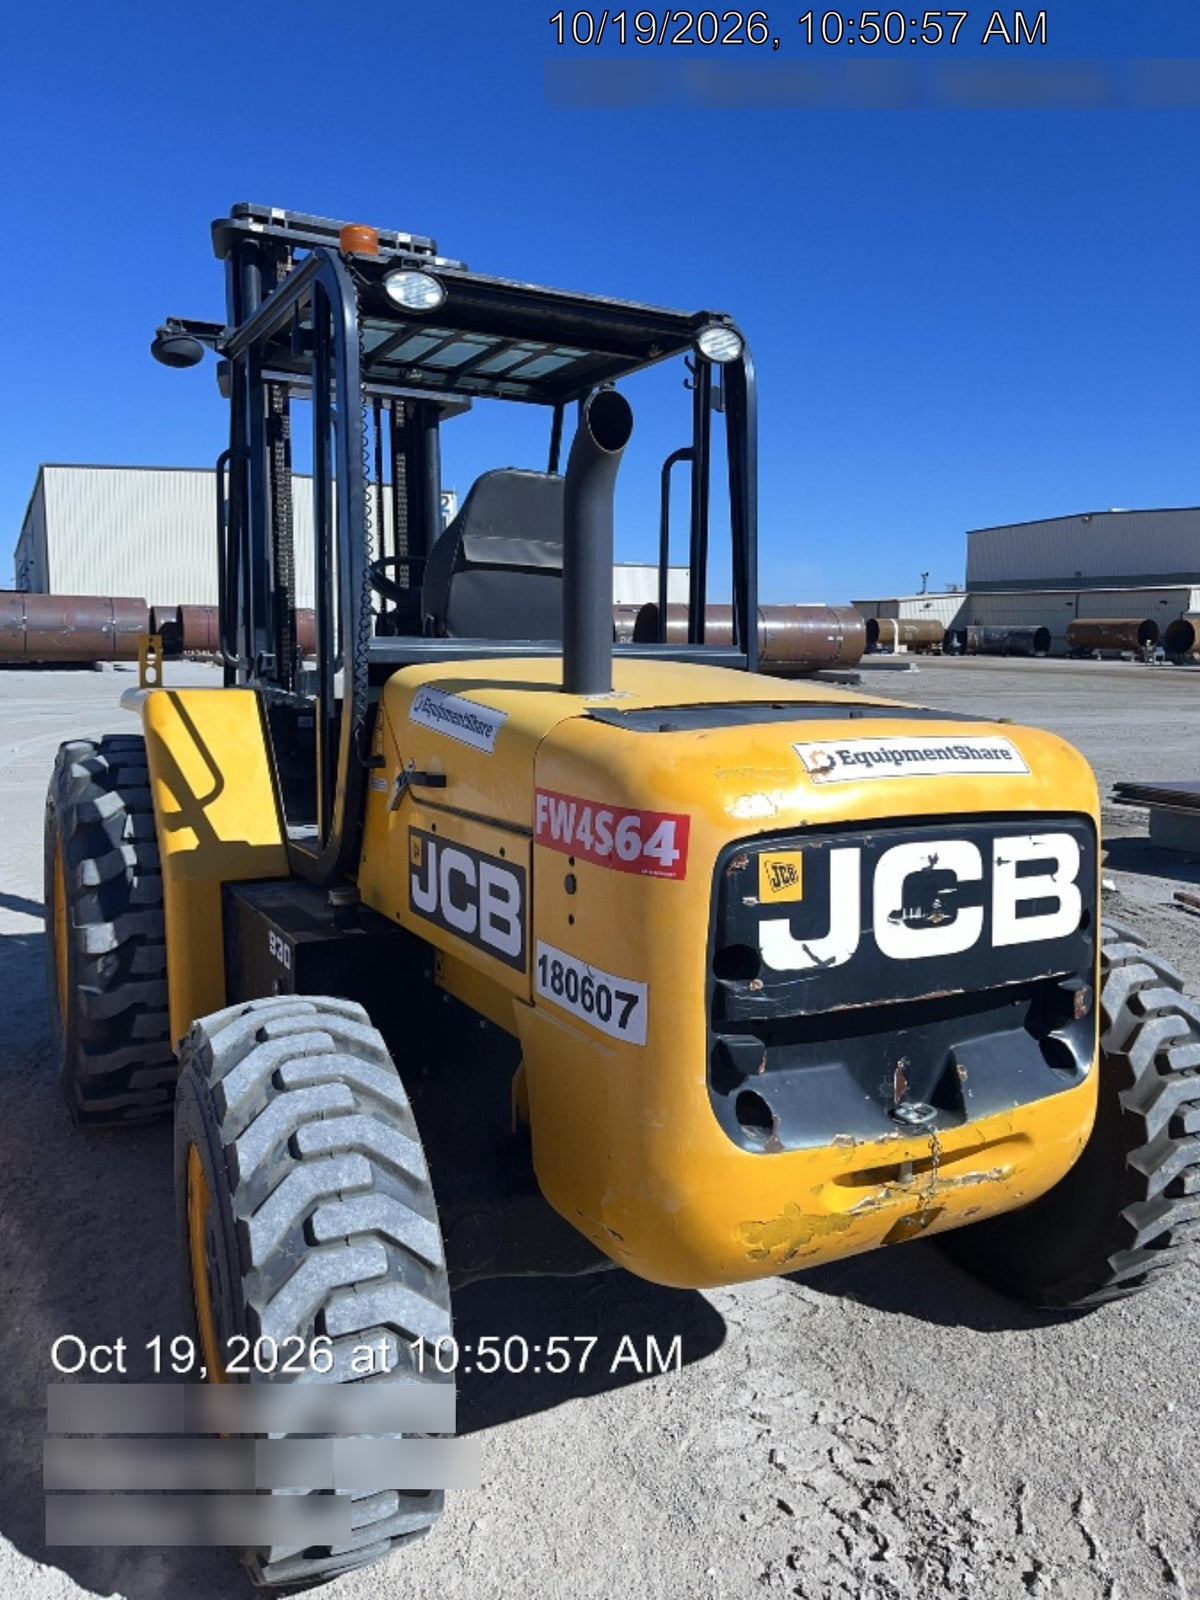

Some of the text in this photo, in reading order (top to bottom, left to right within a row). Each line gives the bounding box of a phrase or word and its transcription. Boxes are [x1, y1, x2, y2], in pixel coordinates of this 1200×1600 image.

[420, 695, 494, 739] EquipmentShare
[835, 743, 1013, 768] EquipmentShare
[535, 793, 680, 867] FW4S64
[411, 841, 522, 957] JCB
[758, 832, 1083, 972] JCB
[268, 929, 291, 970] 930
[538, 953, 639, 1030] 180607
